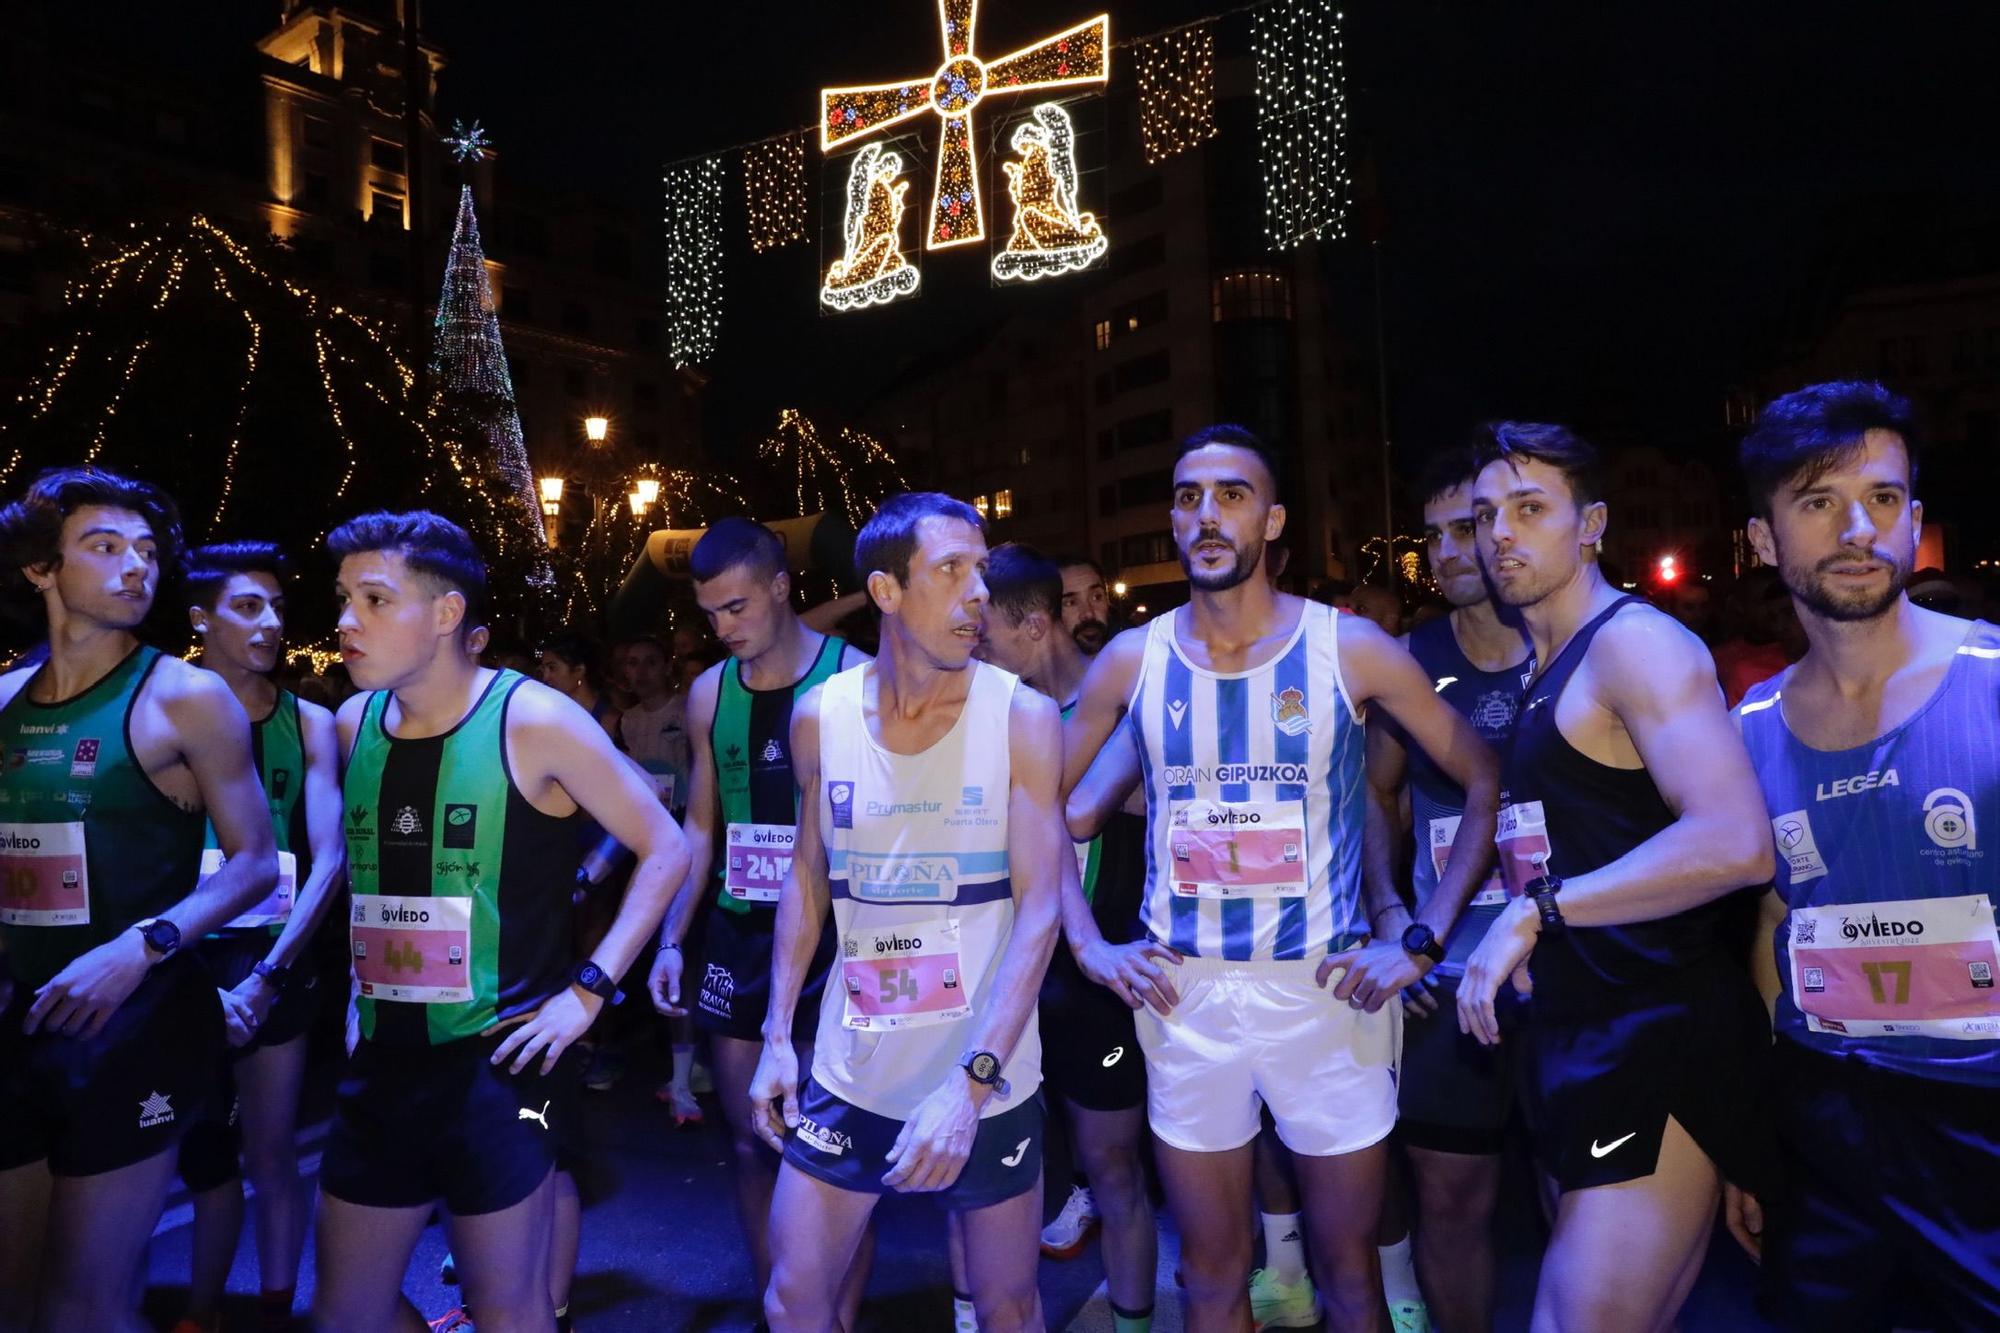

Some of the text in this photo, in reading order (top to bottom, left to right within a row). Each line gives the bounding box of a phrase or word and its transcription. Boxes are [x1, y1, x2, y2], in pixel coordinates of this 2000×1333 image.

[20, 723, 56, 735] luanvi
[1163, 765, 1309, 785] ORAIN GIPUZKOA
[1816, 769, 1900, 801] LEGEA
[866, 800, 943, 817] Prymastur
[1208, 808, 1261, 828] OVIEDO
[754, 829, 794, 844] OVIEDO
[851, 860, 954, 883] PILOÑA
[381, 904, 430, 923] OVIEDO
[1843, 911, 1925, 941] OVIEDO
[875, 934, 923, 953] OVIEDO
[878, 968, 919, 1004] 54
[1861, 960, 1913, 1005] 17
[700, 988, 732, 1013] PRAVIA
[139, 1111, 175, 1129] luanvi
[797, 1113, 853, 1150] PILOÑA
